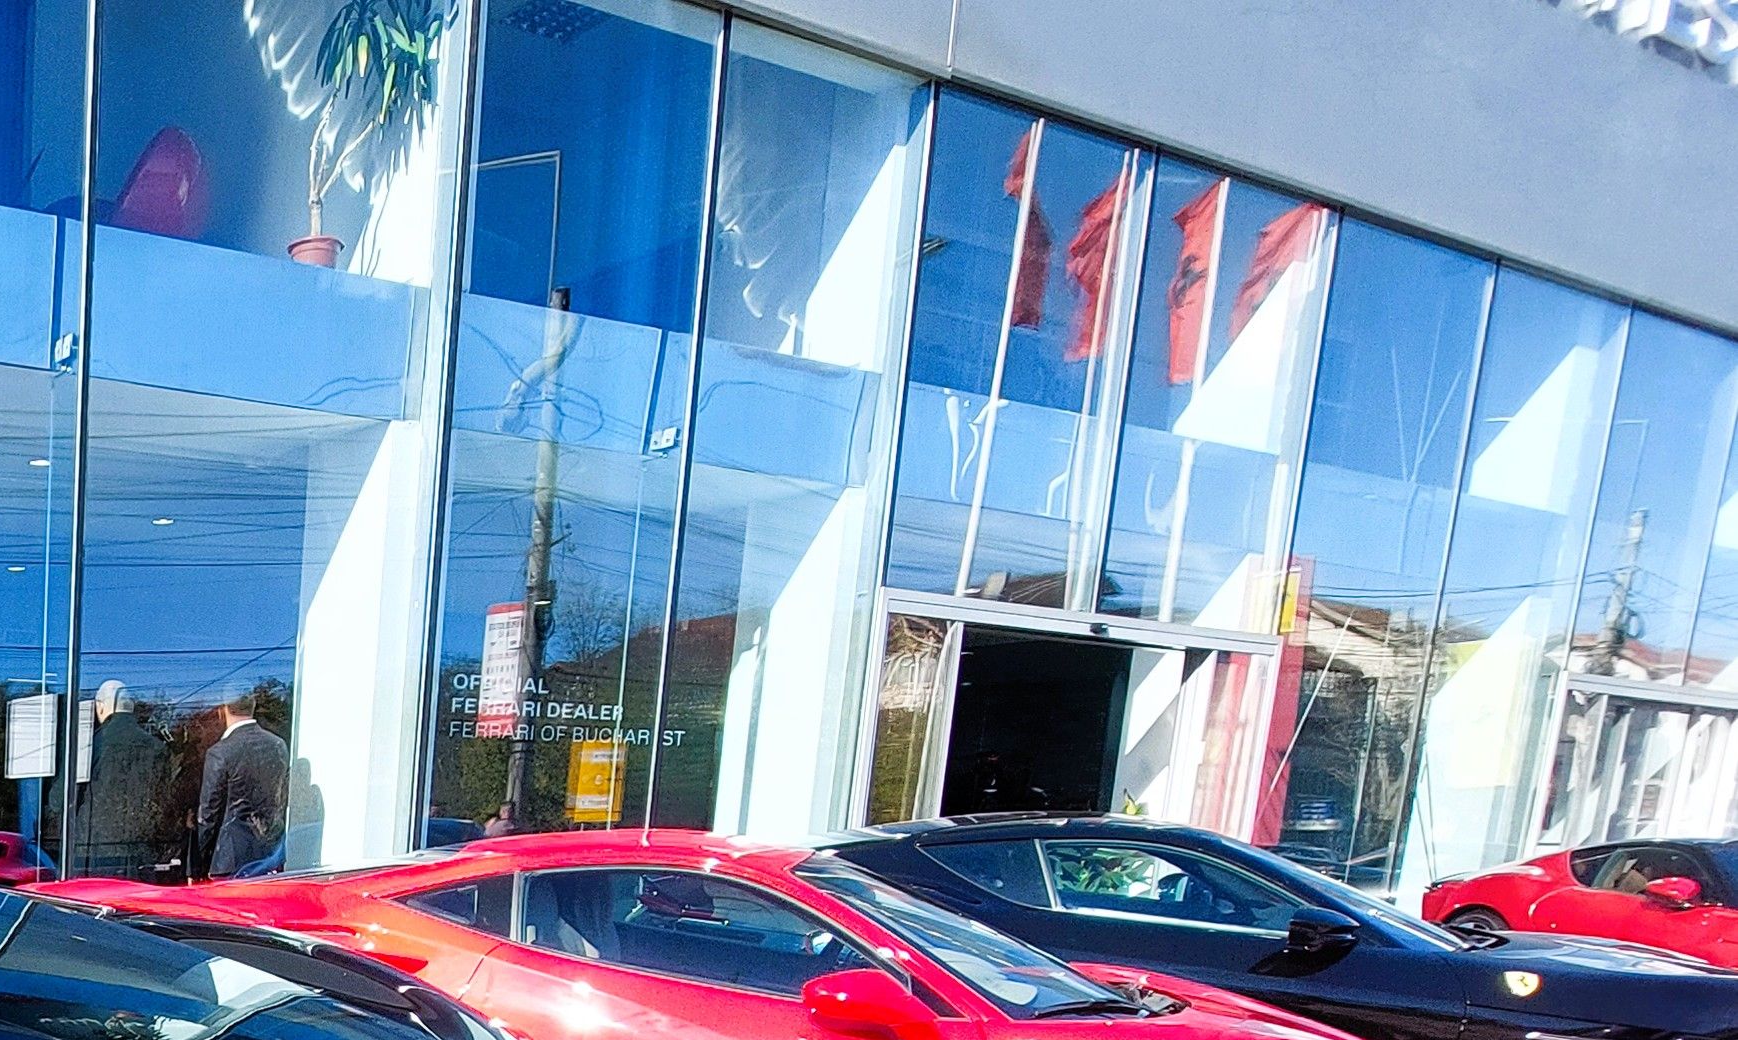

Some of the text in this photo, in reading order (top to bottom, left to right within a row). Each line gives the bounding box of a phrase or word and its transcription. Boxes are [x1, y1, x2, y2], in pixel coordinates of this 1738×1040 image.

[547, 701, 624, 721] DEALER
[449, 721, 686, 746] FERRARI OF BUCHARST
